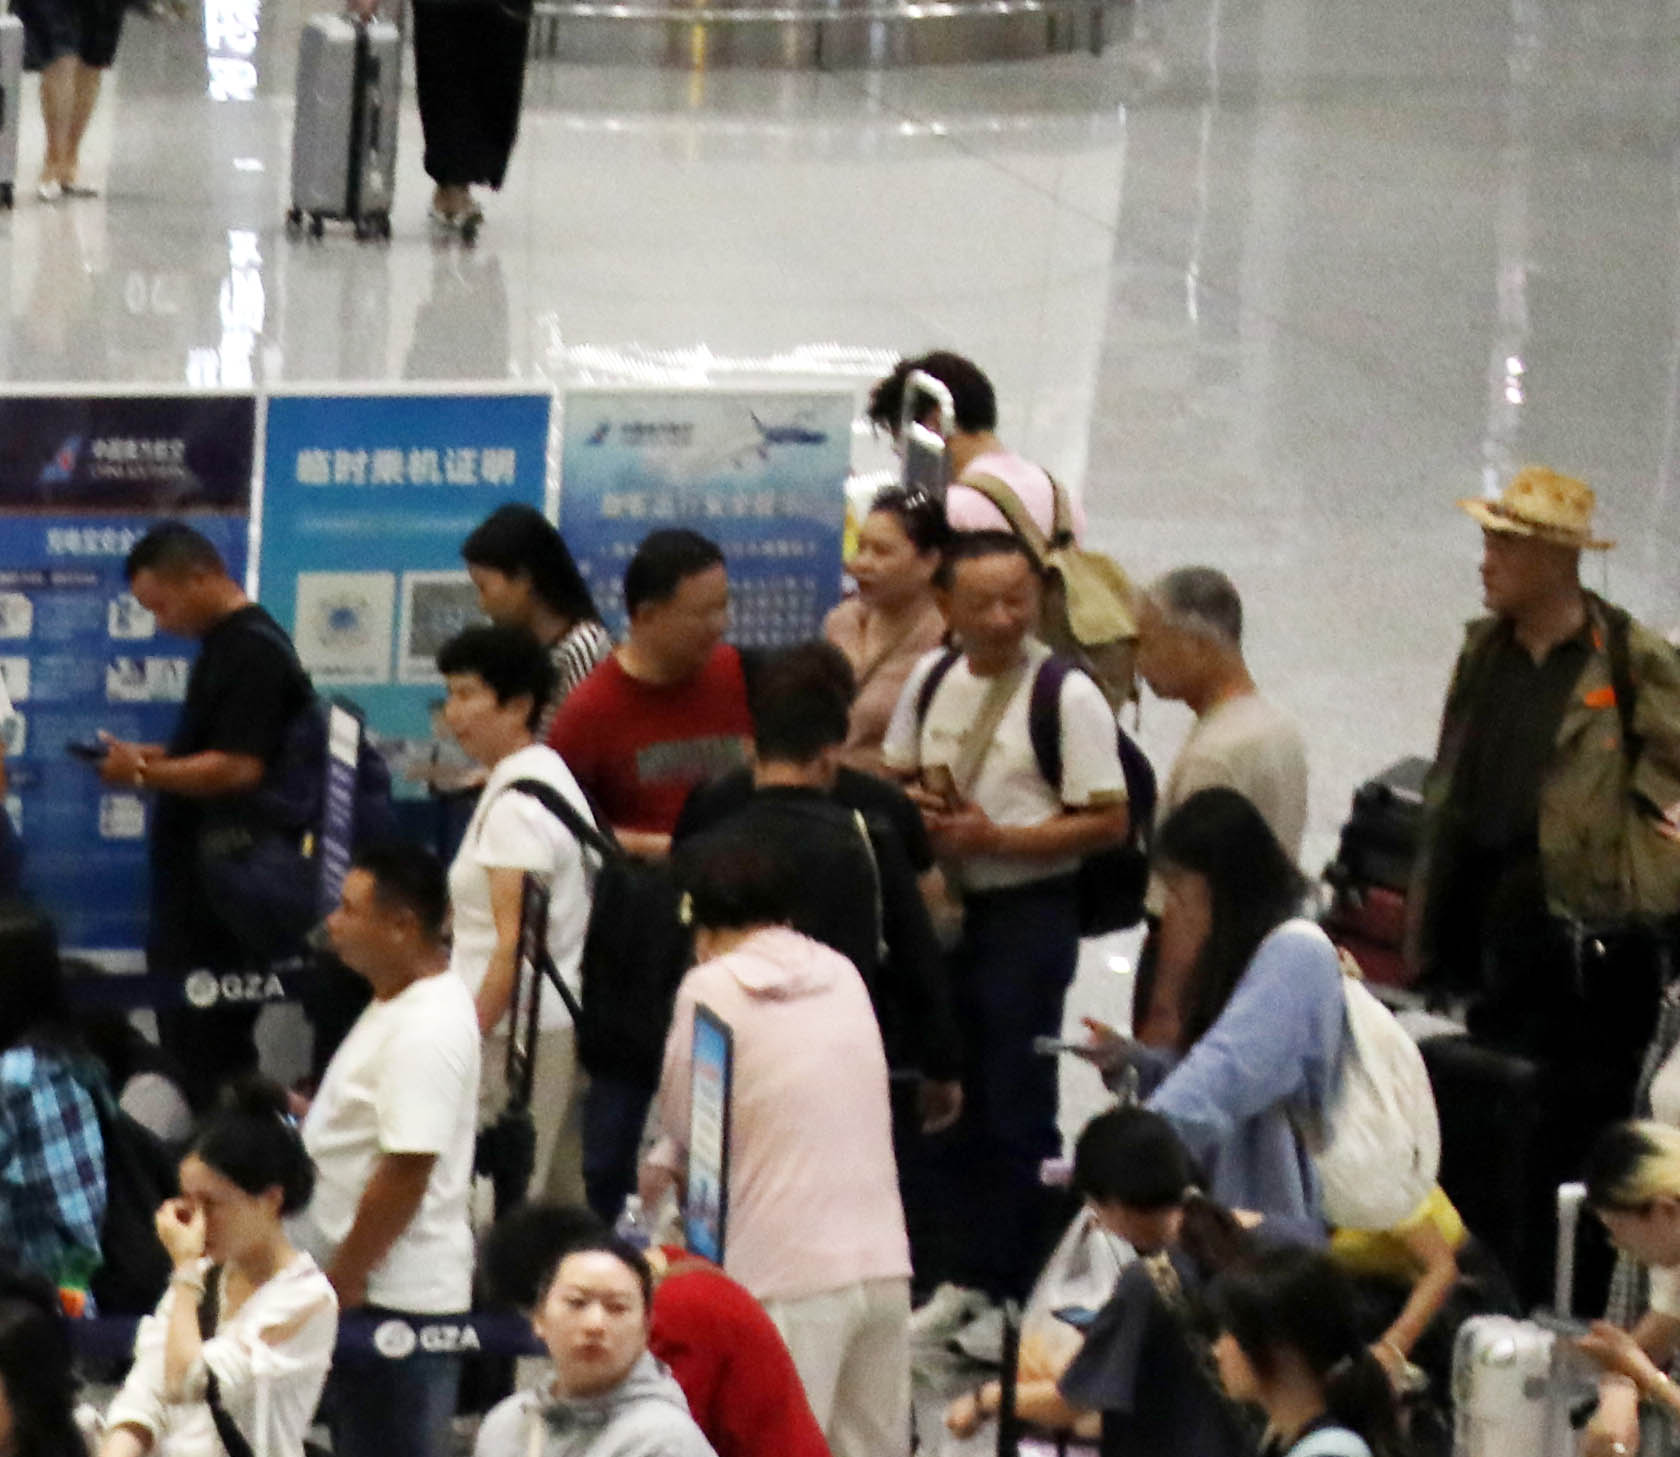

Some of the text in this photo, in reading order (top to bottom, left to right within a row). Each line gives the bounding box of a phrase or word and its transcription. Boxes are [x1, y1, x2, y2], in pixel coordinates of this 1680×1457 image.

[295, 447, 516, 486] 临时乘机证明
[220, 973, 285, 1001] GZA
[419, 1325, 480, 1352] GZA
